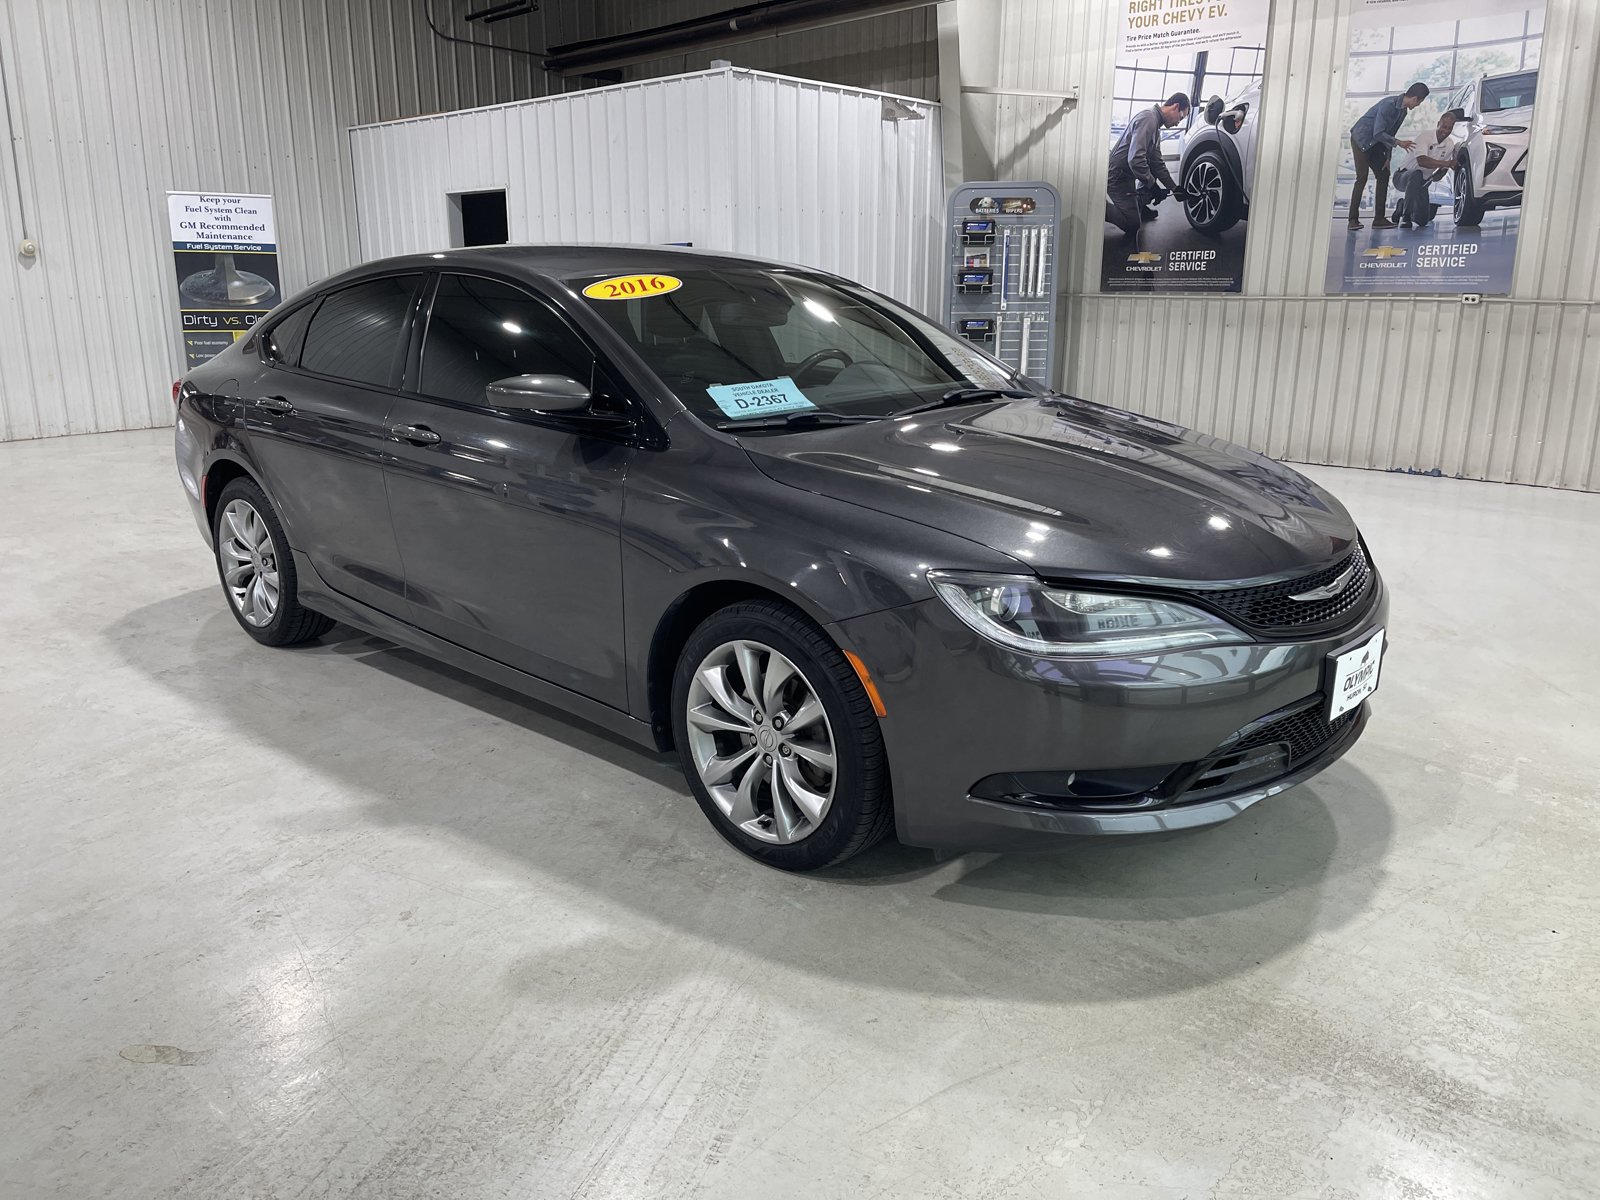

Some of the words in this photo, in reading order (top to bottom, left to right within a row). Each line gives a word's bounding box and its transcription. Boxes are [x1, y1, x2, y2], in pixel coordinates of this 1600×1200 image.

[1129, 0, 1163, 14] RIGHT
[1127, 14, 1159, 29] YOUR
[1162, 7, 1205, 25] CHEVY
[1208, 3, 1228, 19] EV.
[1137, 33, 1152, 41] Price
[1152, 30, 1170, 39] Match
[1170, 28, 1201, 37] Guarantee.
[199, 195, 221, 205] Keep
[184, 205, 202, 213] Fuel
[204, 206, 233, 215] System
[234, 207, 258, 215] Clean
[214, 214, 232, 222] with
[179, 221, 197, 229] GM
[199, 222, 266, 231] Recommended
[196, 231, 253, 240] Maintenance
[204, 243, 233, 251] System
[1417, 243, 1478, 256] CERTIFIED
[1169, 250, 1216, 261] CERTIFIED
[1168, 261, 1207, 271] SERVICE
[1415, 256, 1466, 268] SERVICE
[603, 276, 666, 298] 2016
[183, 315, 218, 327] Dirty
[222, 316, 242, 325] vs.
[751, 382, 774, 390] DAKOTA
[756, 387, 779, 395] DEALER
[734, 393, 789, 409] D-2367
